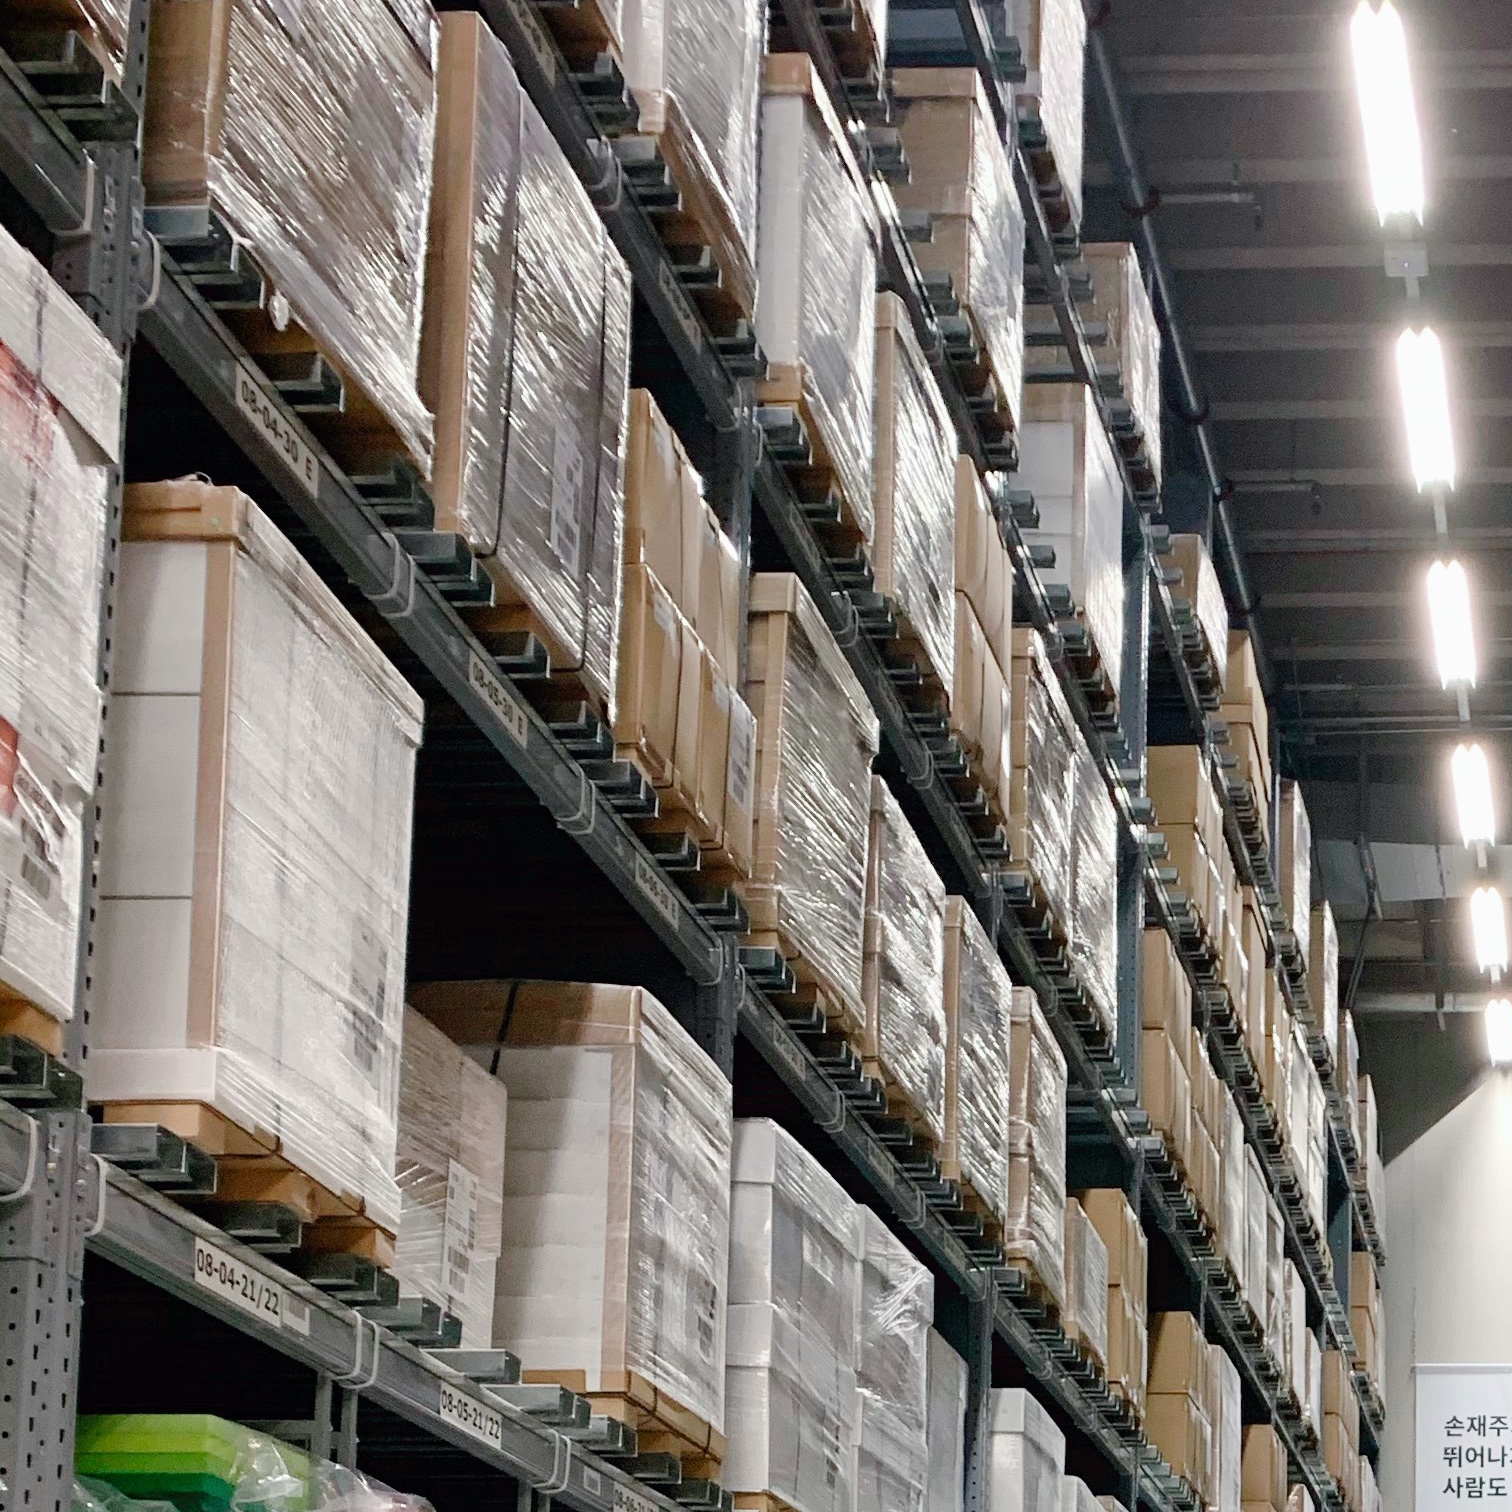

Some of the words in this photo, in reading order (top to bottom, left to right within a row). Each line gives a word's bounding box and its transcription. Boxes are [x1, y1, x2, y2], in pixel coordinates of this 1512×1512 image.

[196, 1248, 279, 1316] 08-04-21/22
[442, 1390, 500, 1440] 08-05-21/22
[1442, 1476, 1508, 1499] 사람도
